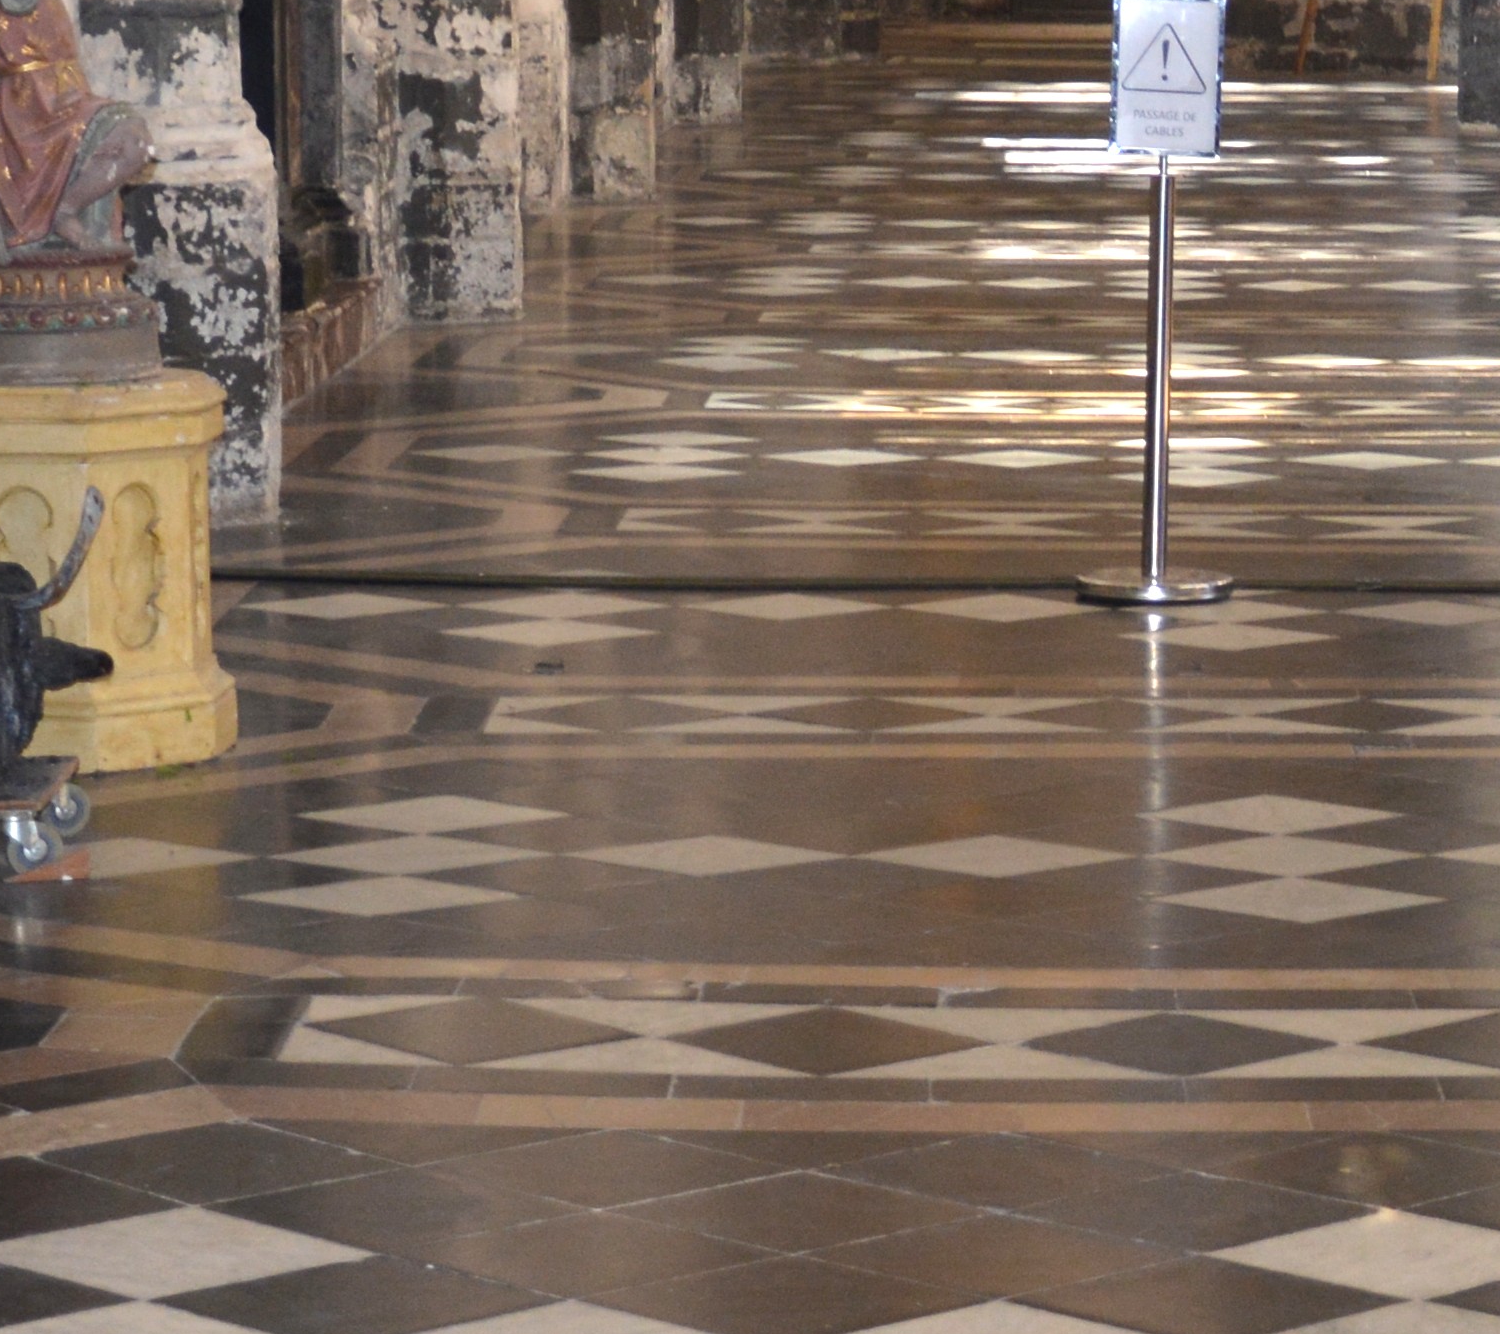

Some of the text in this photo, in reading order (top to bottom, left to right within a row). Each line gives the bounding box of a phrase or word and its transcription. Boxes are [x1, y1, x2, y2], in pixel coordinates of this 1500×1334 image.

[1133, 109, 1197, 122] PASSAGE DE
[1145, 126, 1184, 137] CABLES
